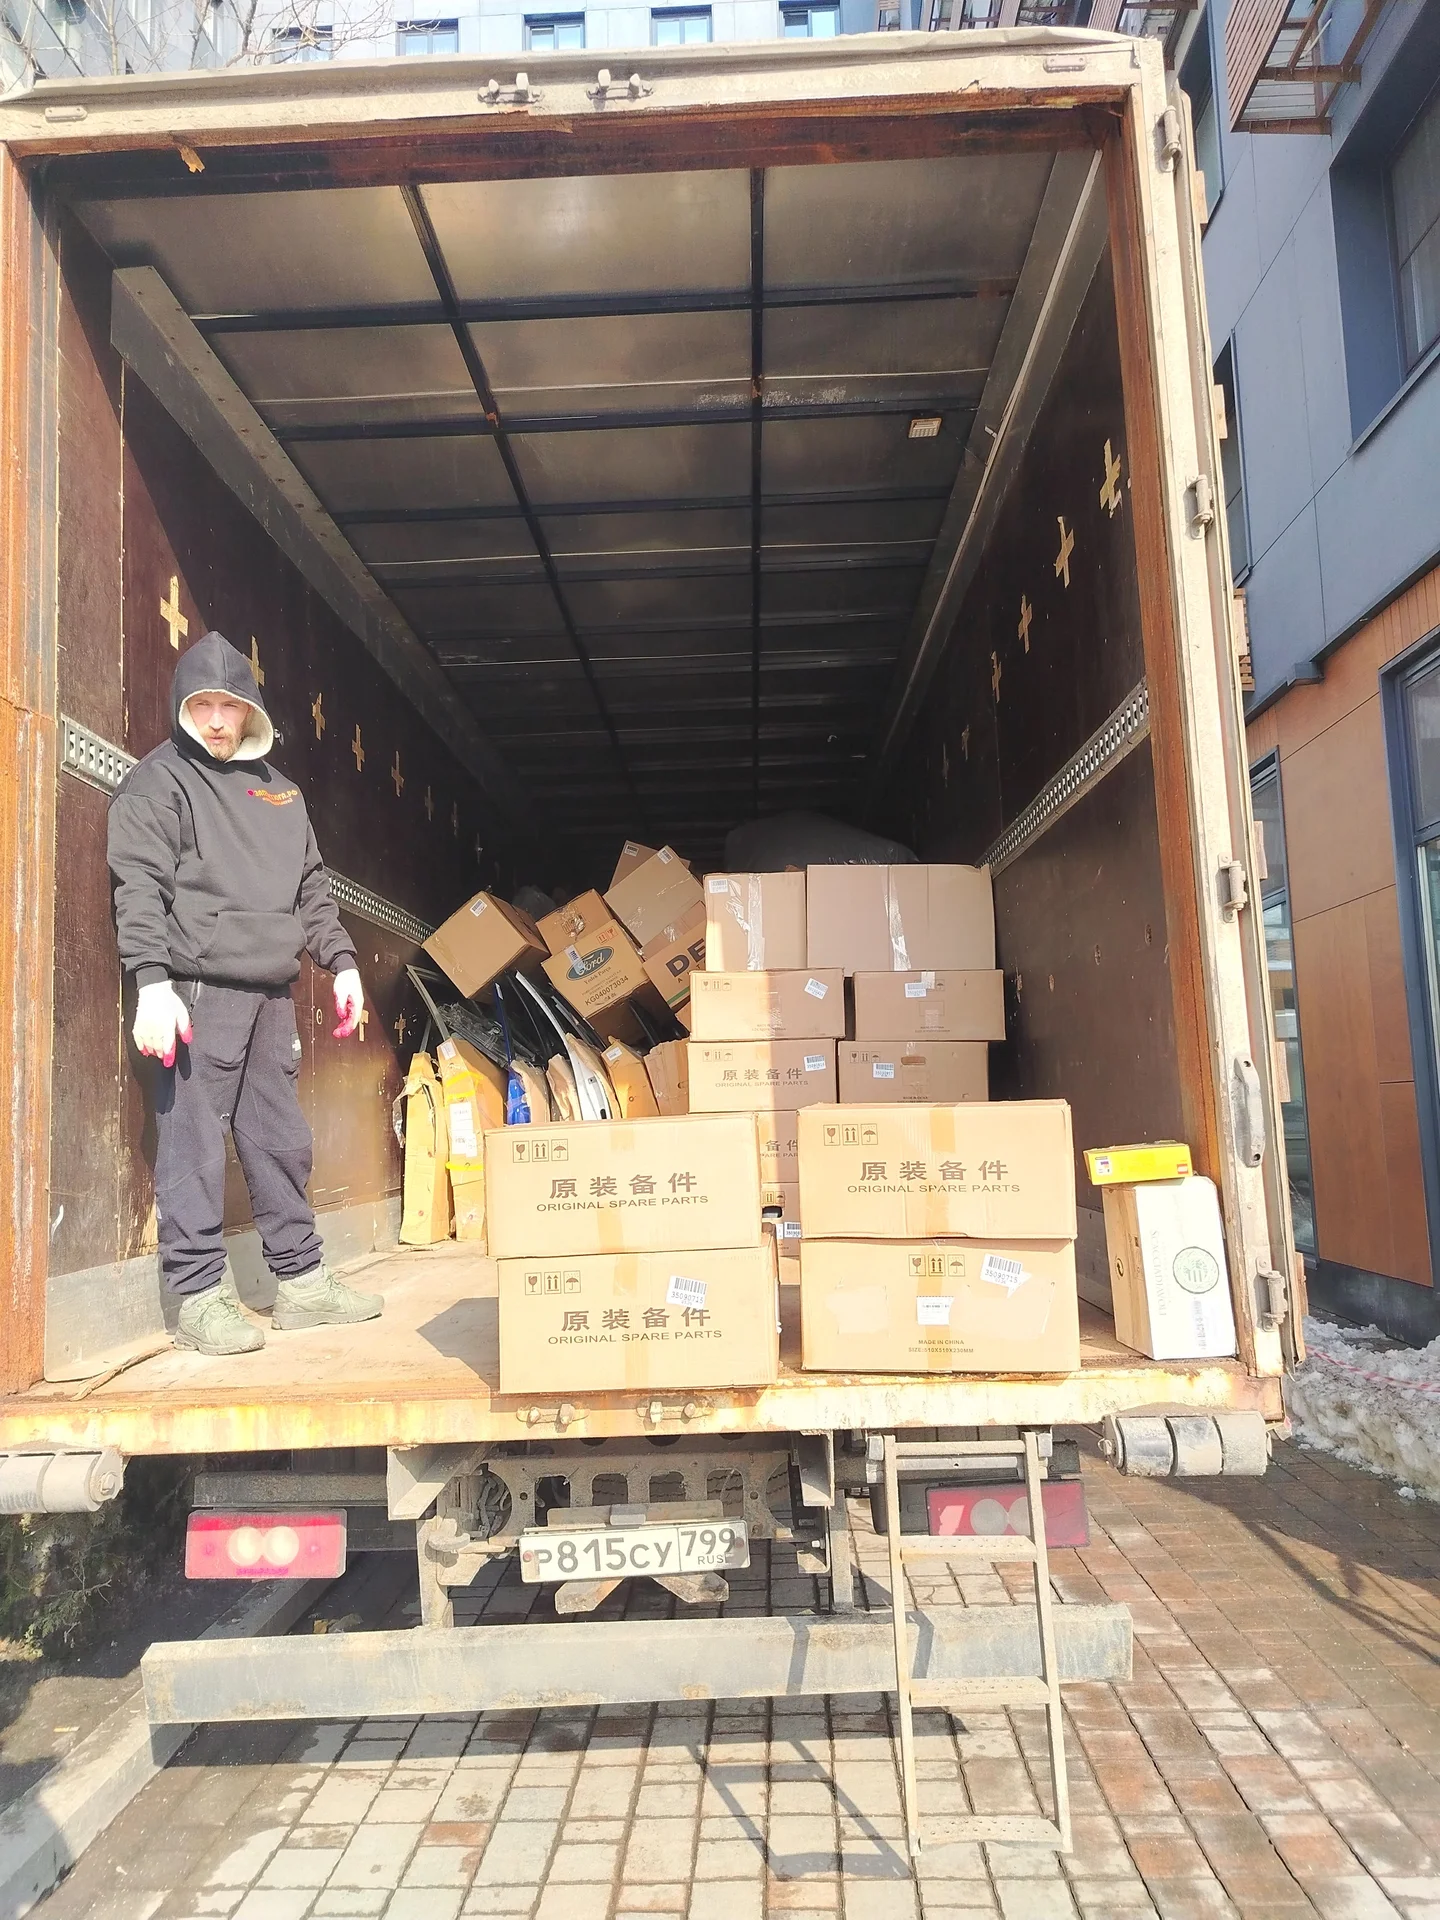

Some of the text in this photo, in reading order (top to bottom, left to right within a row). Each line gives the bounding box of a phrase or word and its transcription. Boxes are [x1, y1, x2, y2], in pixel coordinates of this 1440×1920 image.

[574, 952, 605, 976] Ford
[584, 975, 629, 1006] KG040073034
[722, 1067, 803, 1081] 原装备件
[860, 1160, 1009, 1182] 原装备件
[549, 1171, 698, 1199] 原装备件
[847, 1184, 1021, 1193] ORIGINAL SPARE PARTS
[536, 1195, 709, 1212] ORIGINAL SPARE PARTS
[561, 1306, 711, 1332] 原装备件
[547, 1329, 722, 1345] ORIGINAL SPARE PARTS
[680, 1528, 737, 1557] 799
[697, 1555, 724, 1566] RUS
